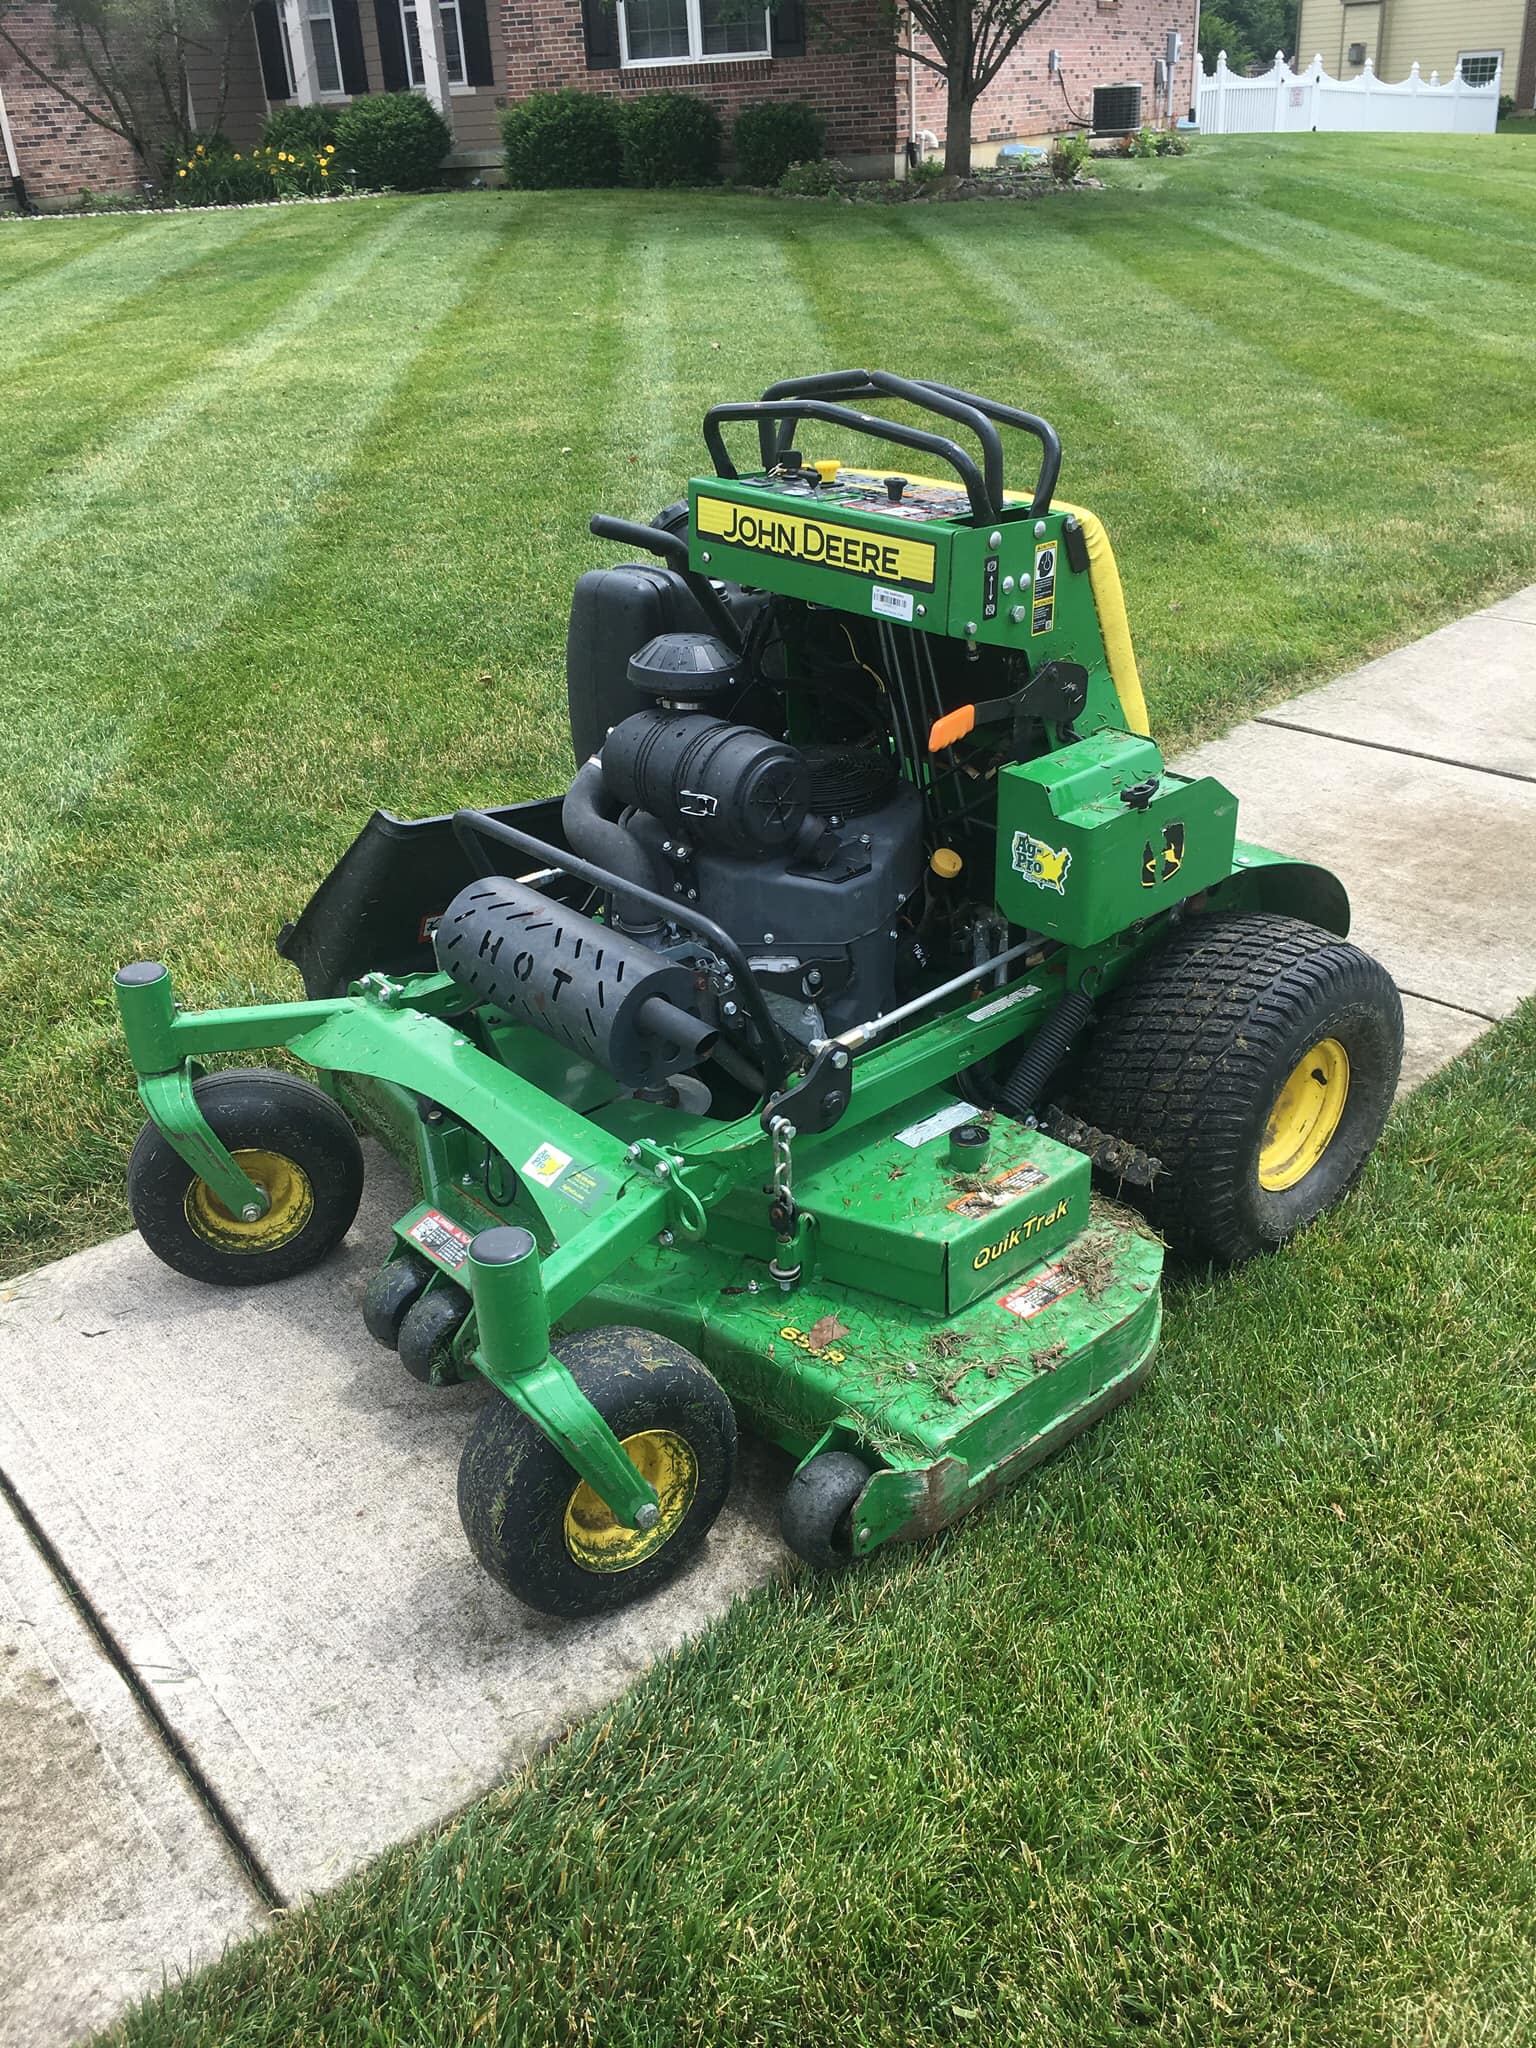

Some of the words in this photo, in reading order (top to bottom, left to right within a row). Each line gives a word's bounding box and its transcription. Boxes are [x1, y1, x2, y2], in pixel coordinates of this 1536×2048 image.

[724, 508, 796, 552] JOHN
[803, 523, 900, 576] DEERE
[1016, 852, 1042, 873] Pro
[478, 929, 573, 1002] HOT
